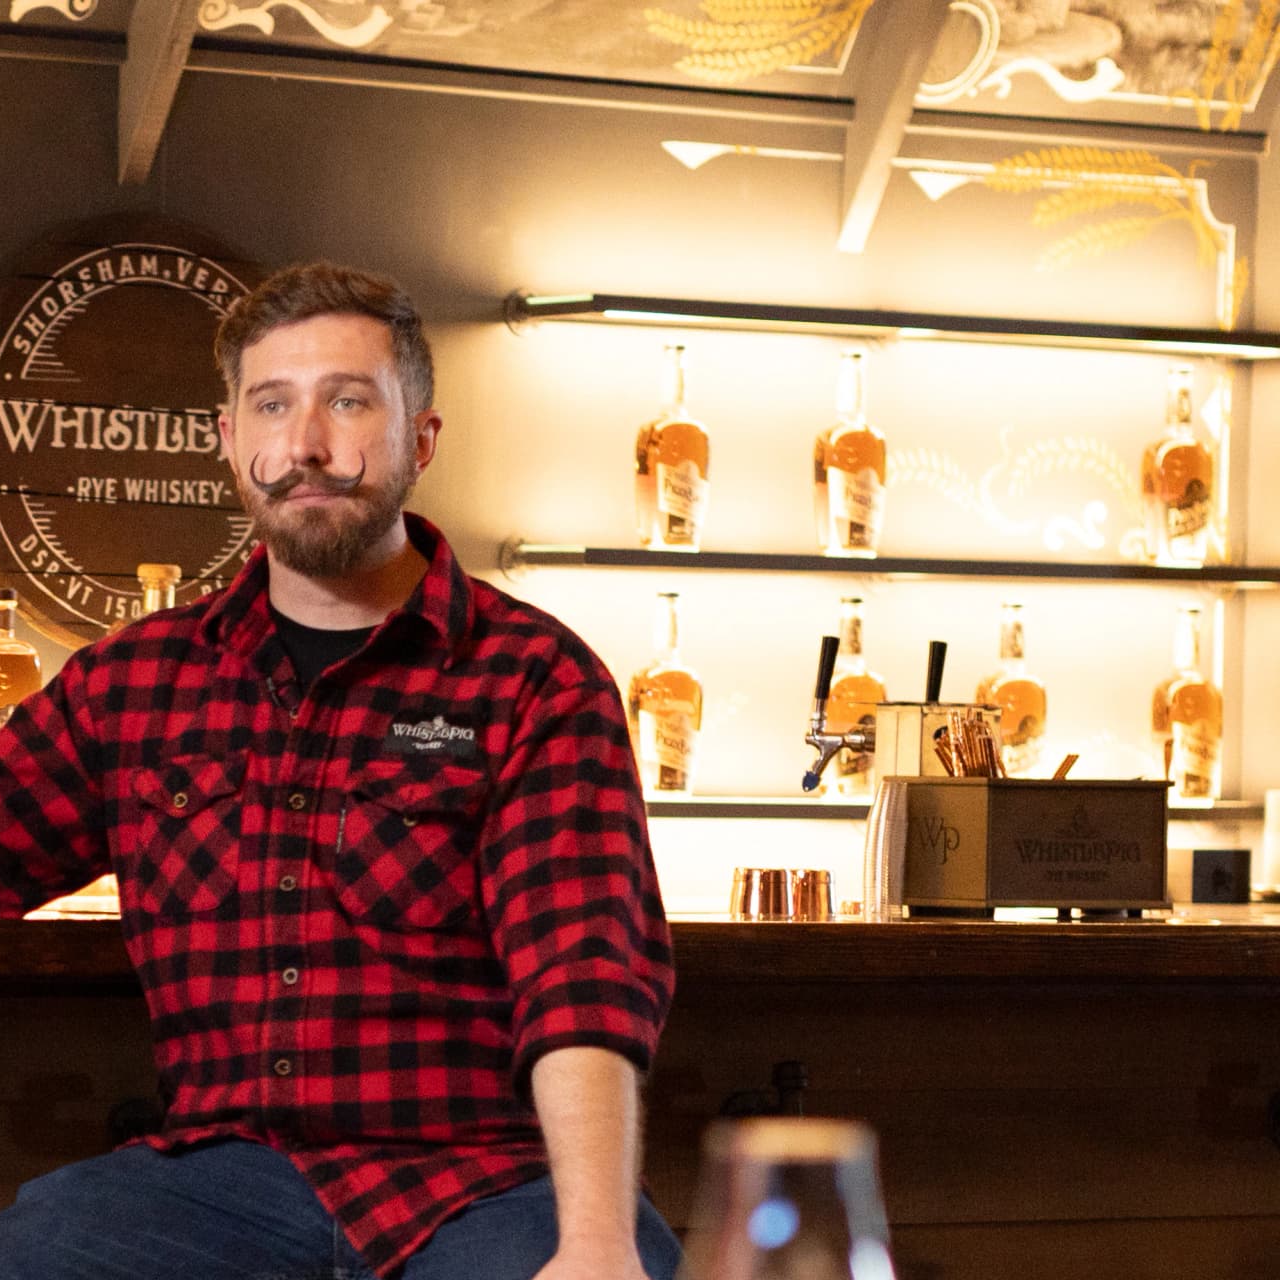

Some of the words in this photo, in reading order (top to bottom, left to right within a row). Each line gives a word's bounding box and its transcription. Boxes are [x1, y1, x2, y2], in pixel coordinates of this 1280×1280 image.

[177, 257, 241, 315] VER
[77, 476, 118, 504] RYE
[124, 478, 225, 505] WHISKEY
[105, 595, 142, 618] 150
[392, 721, 475, 742] WHISTEPIG
